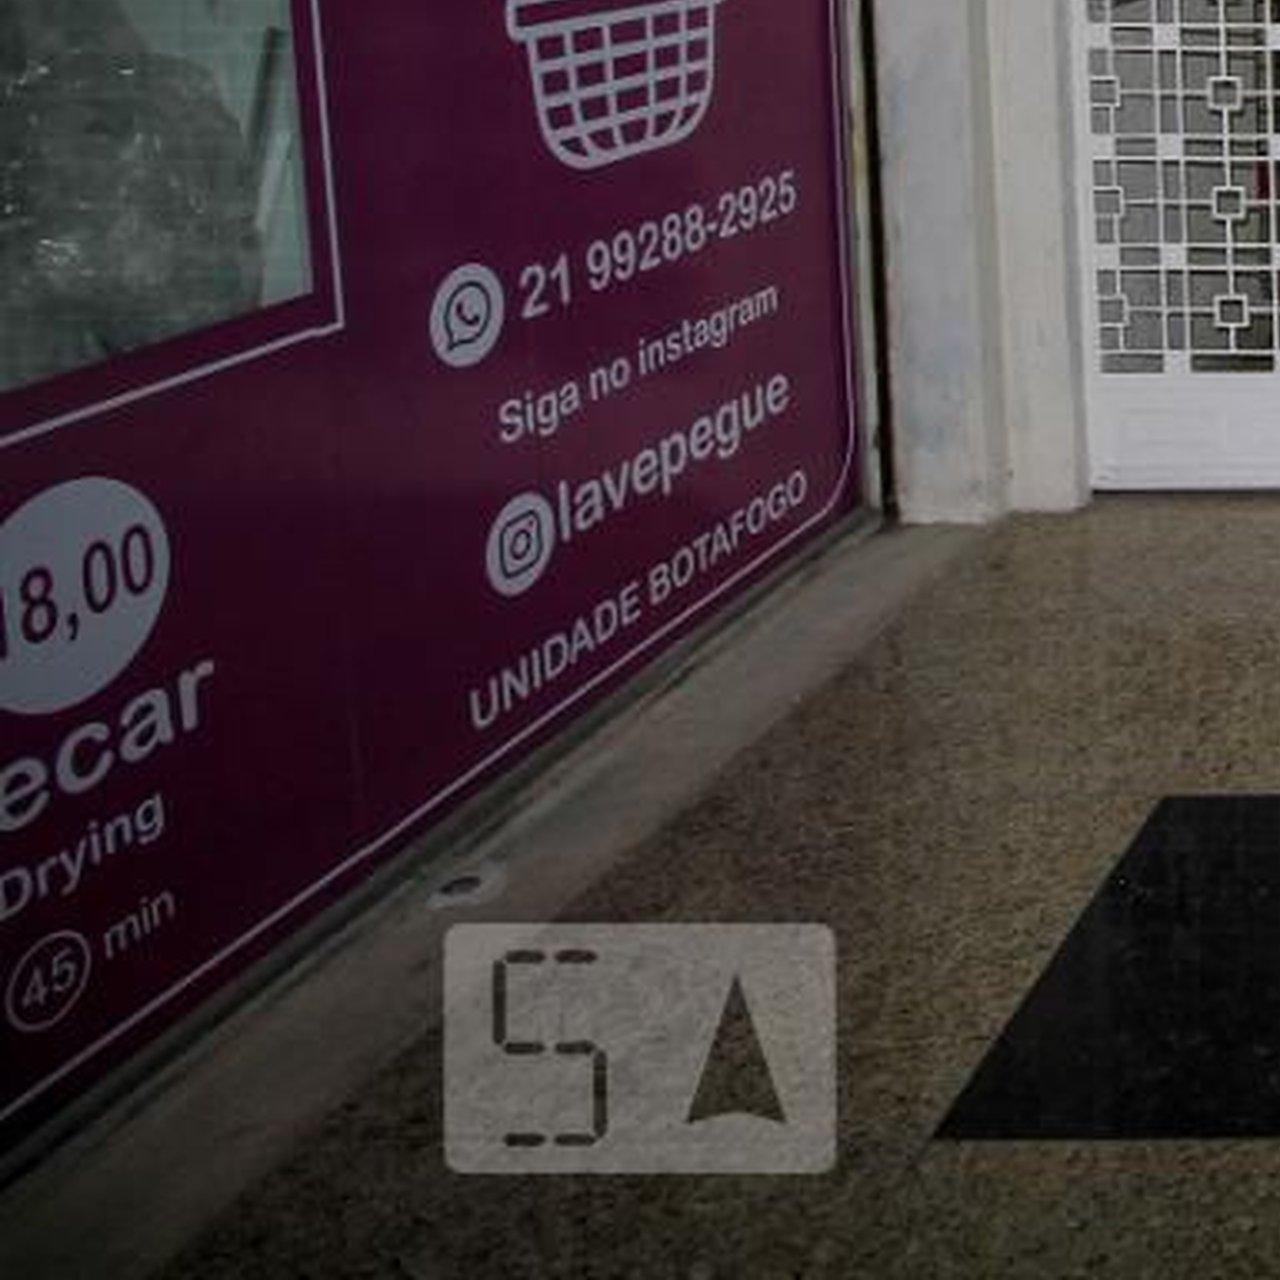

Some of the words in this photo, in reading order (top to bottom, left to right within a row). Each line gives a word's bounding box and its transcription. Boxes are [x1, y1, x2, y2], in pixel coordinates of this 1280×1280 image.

[519, 253, 572, 320] 21
[585, 169, 799, 292] 99288-2925
[499, 383, 580, 444] Siga
[589, 356, 632, 403] no
[638, 283, 780, 376] instagram
[558, 372, 791, 544] lavepegue
[469, 580, 643, 731] UNIDADE
[649, 468, 808, 608] BOTAFOGO
[0, 792, 165, 919] Drying
[21, 947, 77, 1009] 45
[103, 890, 176, 959] min
